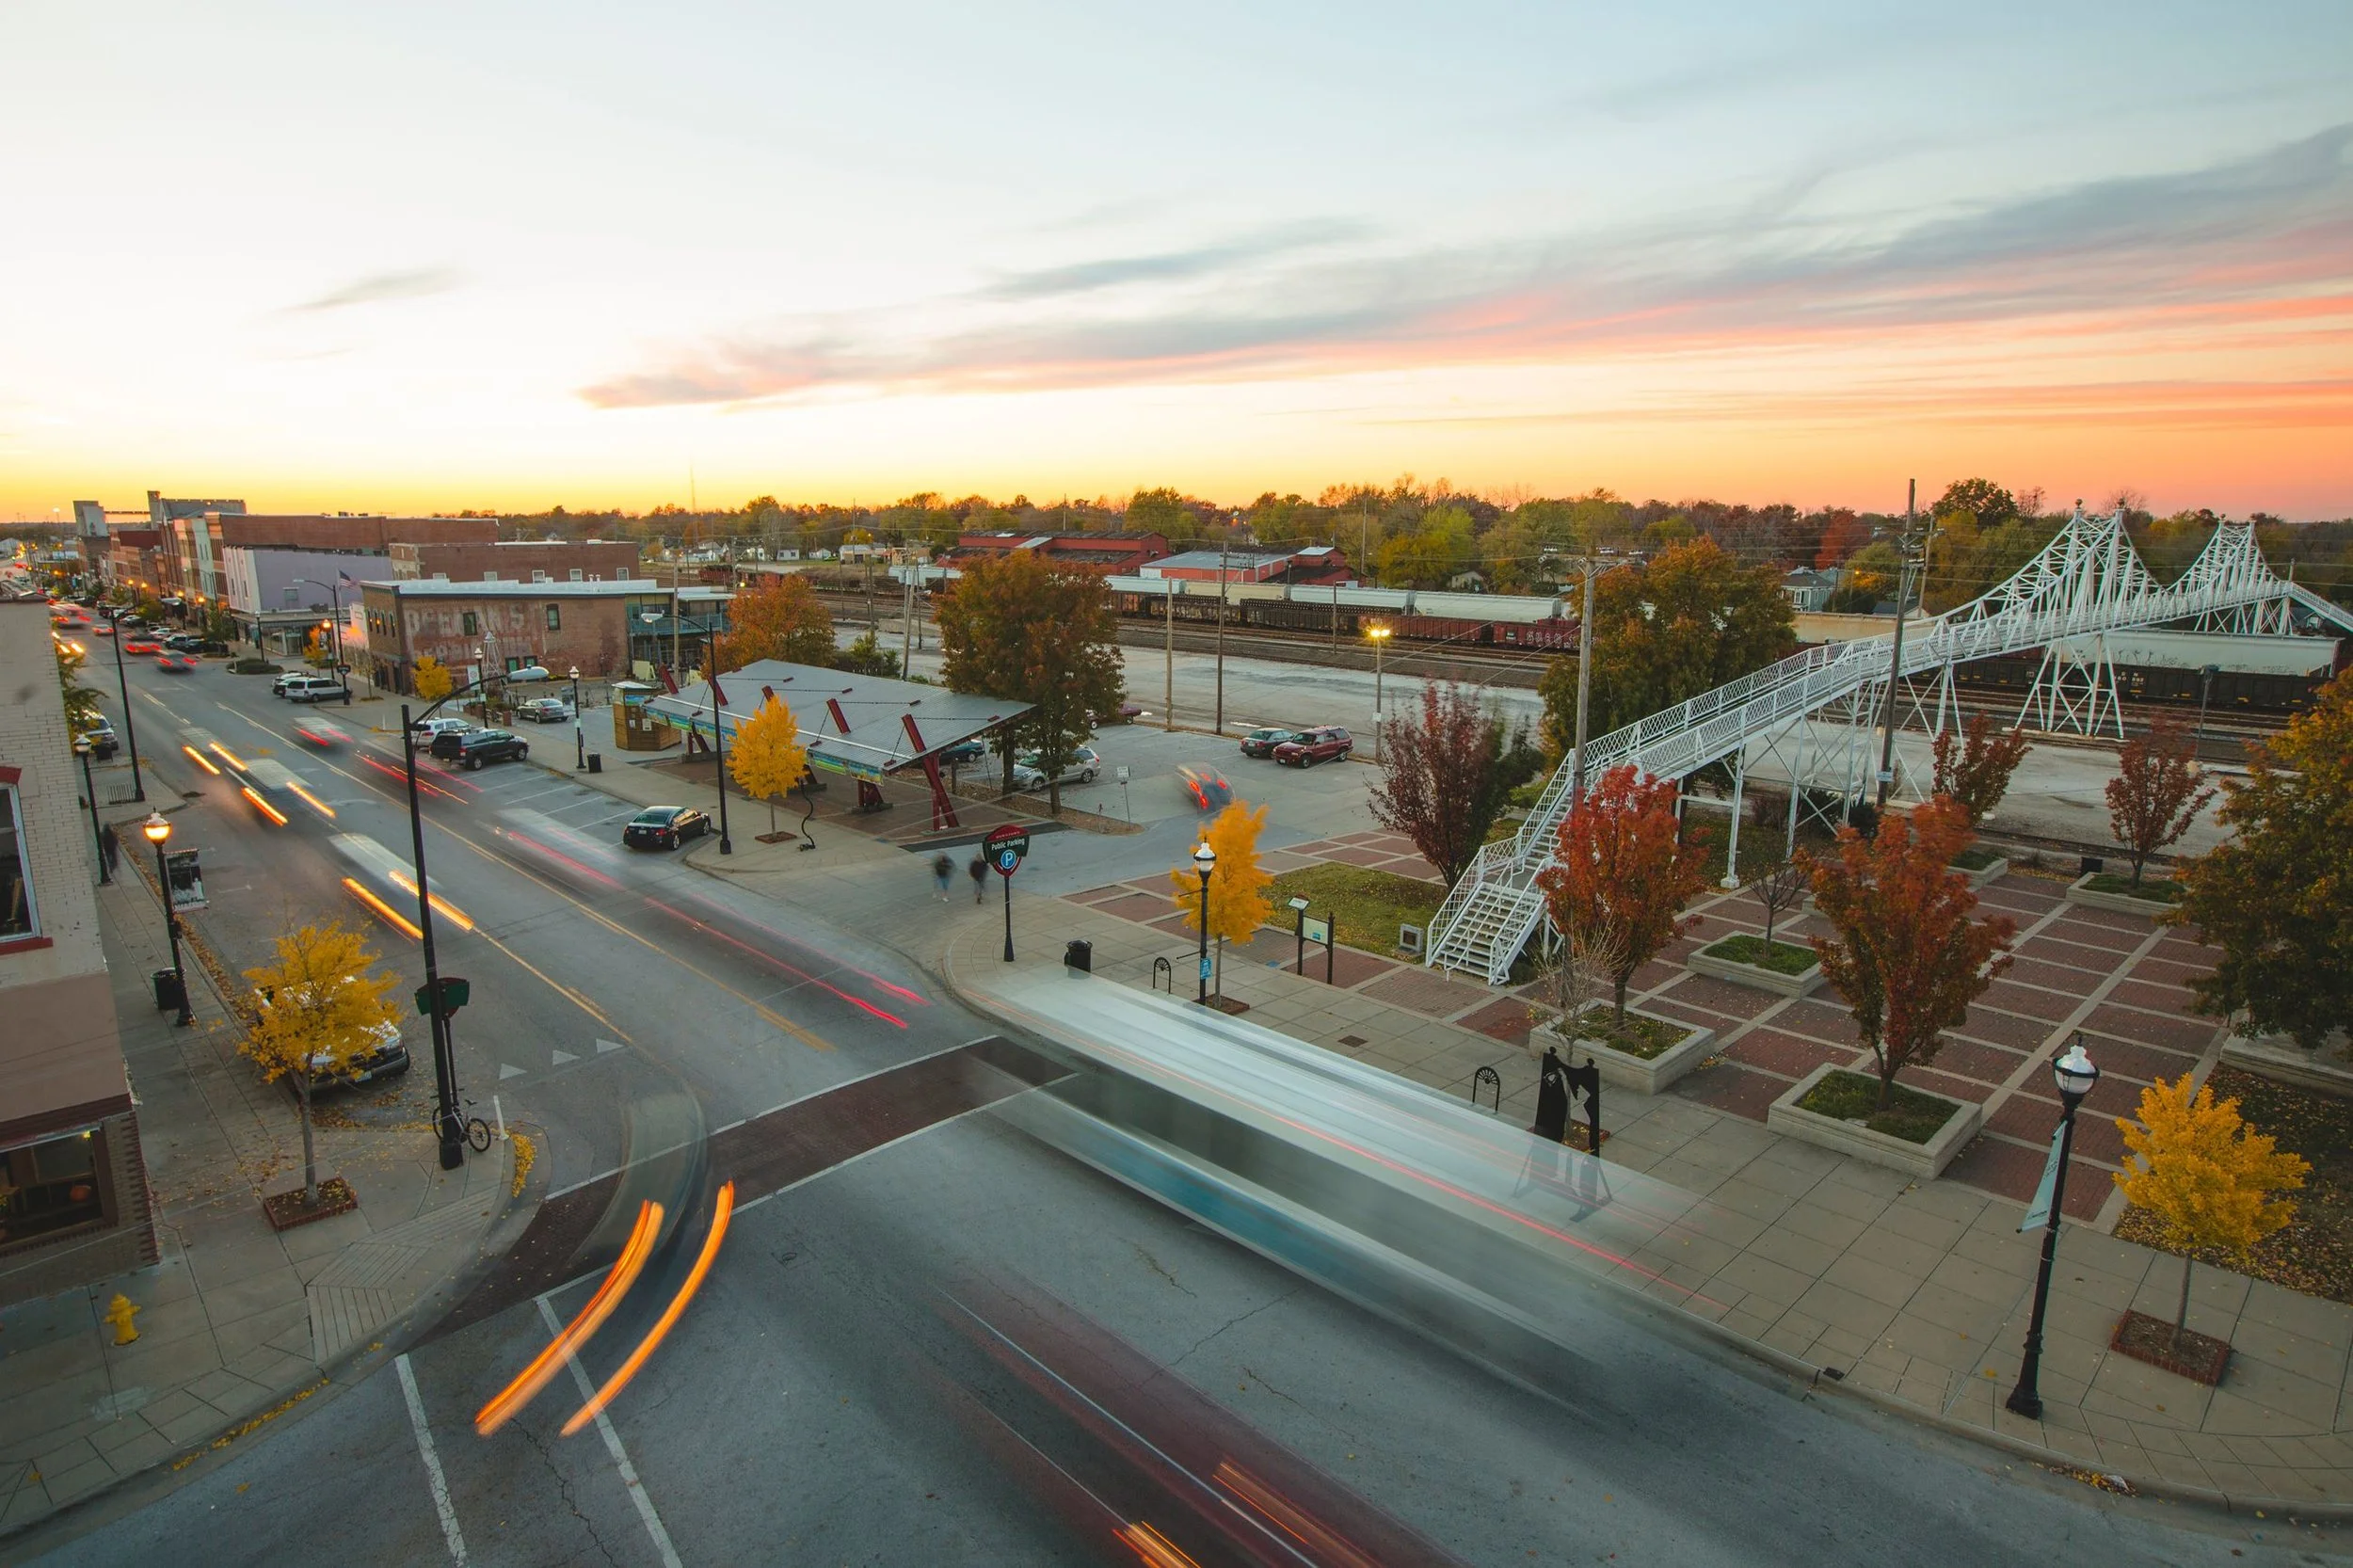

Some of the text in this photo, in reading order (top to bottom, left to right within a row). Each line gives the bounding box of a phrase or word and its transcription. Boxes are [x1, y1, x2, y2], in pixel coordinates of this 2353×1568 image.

[991, 838, 1025, 851] Public Parking
[1005, 852, 1013, 866] P
